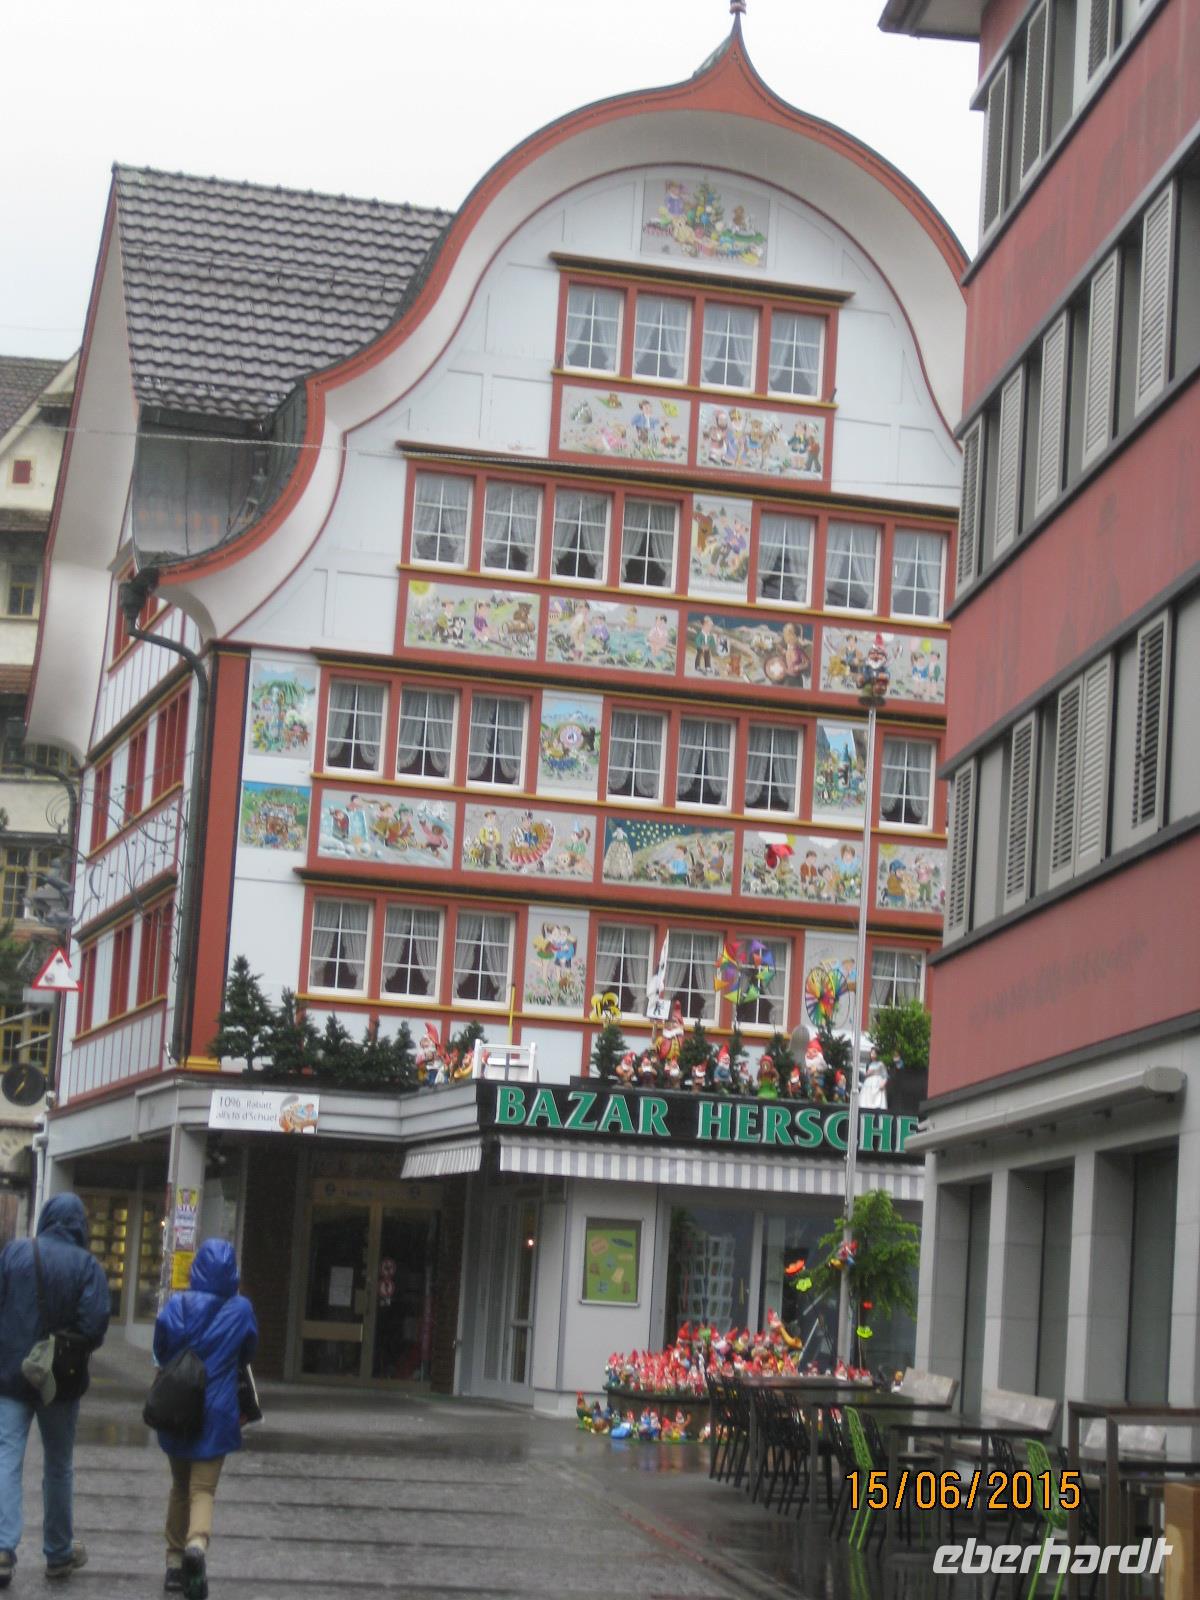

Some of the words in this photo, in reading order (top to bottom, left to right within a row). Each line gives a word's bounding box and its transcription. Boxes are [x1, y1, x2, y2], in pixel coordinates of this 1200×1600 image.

[219, 1095, 241, 1109] 10%
[246, 1099, 272, 1111] Rabatt
[495, 1086, 672, 1137] BAZAR
